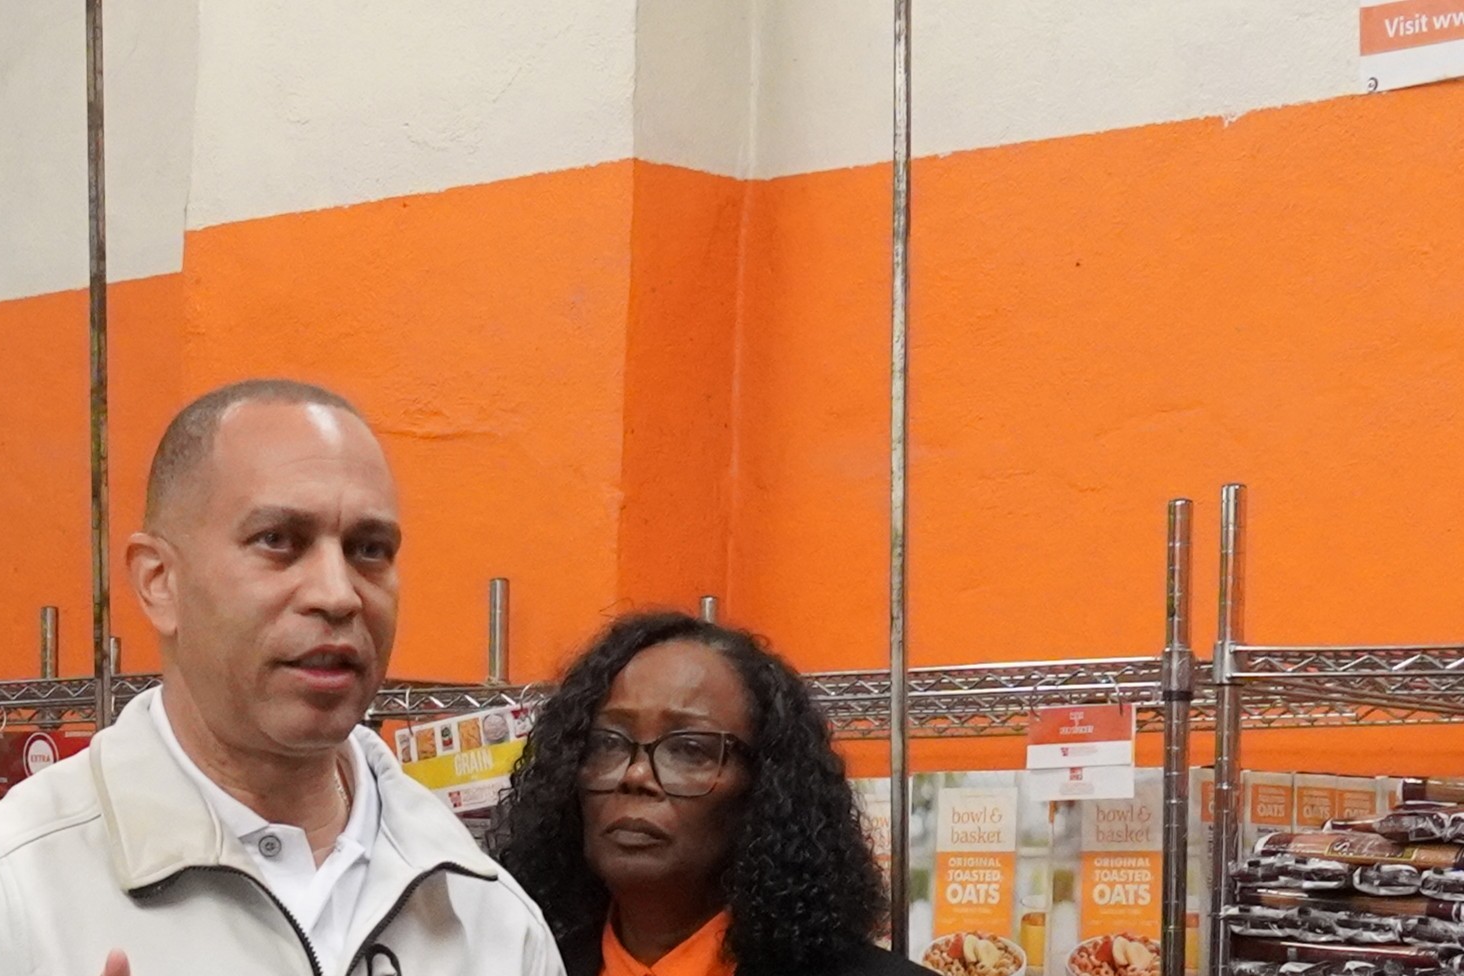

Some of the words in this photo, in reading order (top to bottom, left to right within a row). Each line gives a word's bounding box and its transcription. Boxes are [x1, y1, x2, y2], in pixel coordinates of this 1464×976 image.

[1384, 13, 1429, 38] Visit
[454, 746, 493, 776] GRAIN
[951, 806, 987, 824] bowl
[989, 807, 1003, 824] &
[1096, 805, 1134, 822] bowl
[1137, 806, 1151, 823] &
[1257, 804, 1286, 817] OATS
[950, 825, 1003, 844] basket
[1096, 824, 1151, 843] basket
[948, 857, 1002, 868] ORIGINAL
[1094, 857, 1151, 867] ORIGINAL
[948, 869, 1002, 882] TOASTED
[1094, 869, 1152, 882] TOASTED
[945, 882, 1001, 905] OATS
[1092, 883, 1152, 906] OATS
